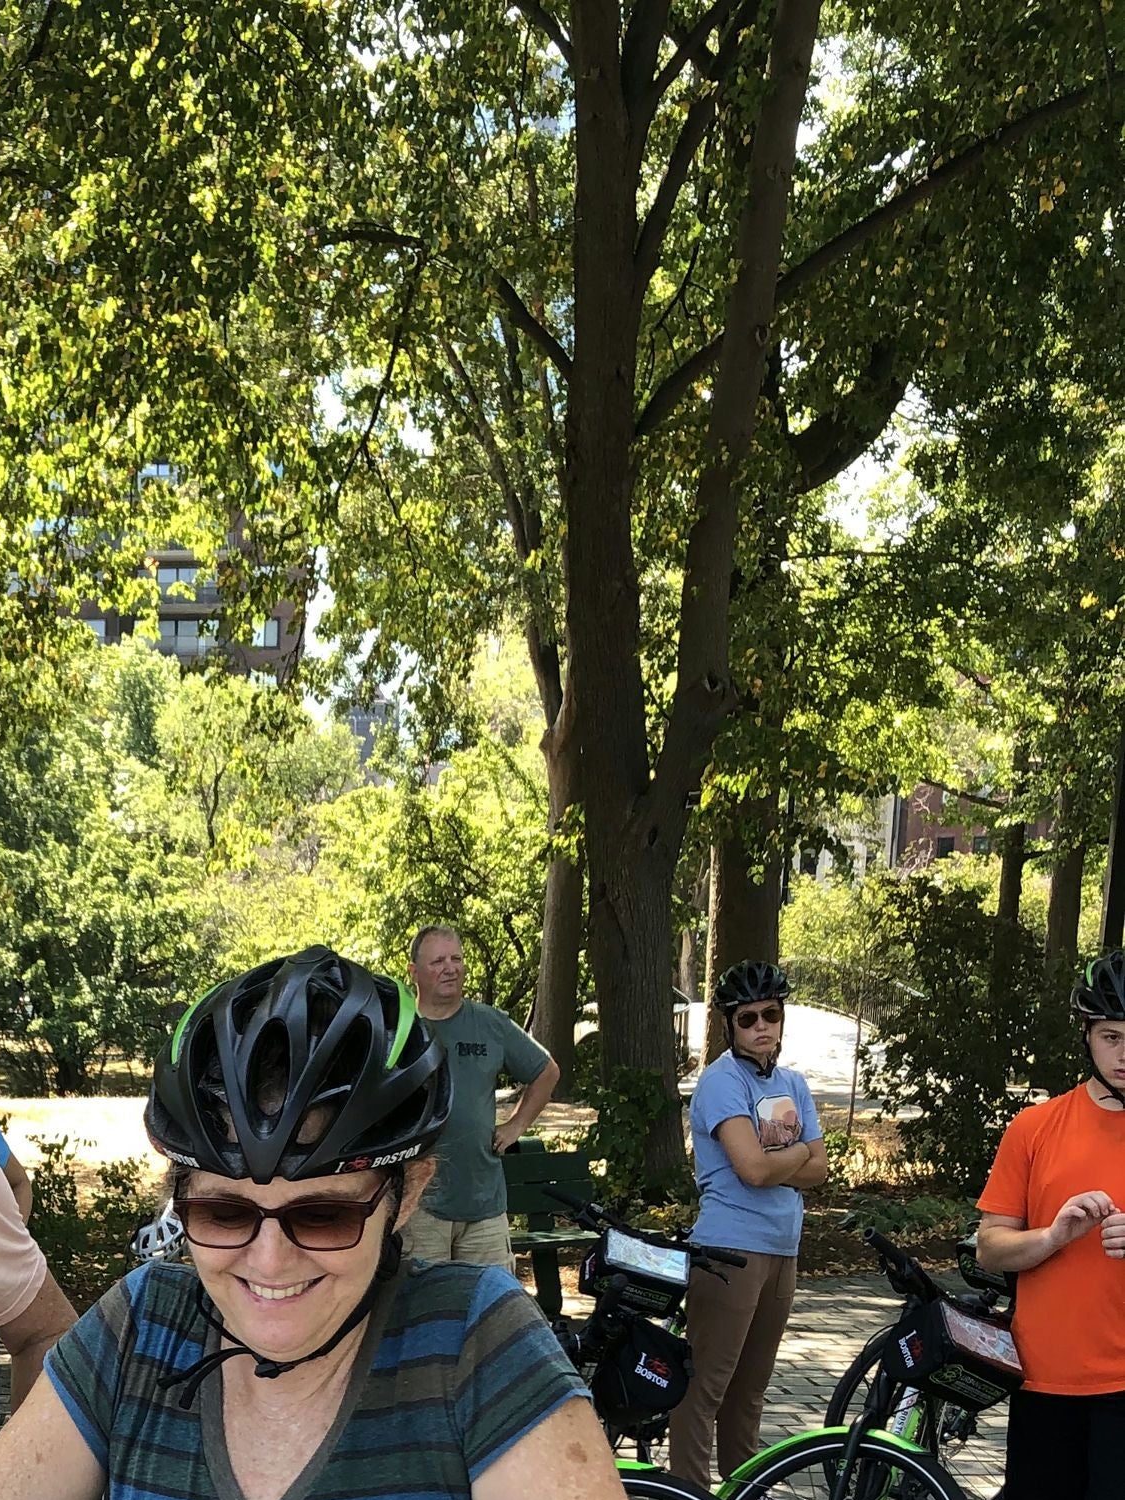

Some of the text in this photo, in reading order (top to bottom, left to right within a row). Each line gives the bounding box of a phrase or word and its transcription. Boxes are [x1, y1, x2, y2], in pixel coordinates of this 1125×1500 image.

[371, 1144, 422, 1168] BOSTON
[638, 1352, 647, 1366] I
[898, 1338, 914, 1369] BOSTON
[634, 1364, 669, 1388] BOSTON
